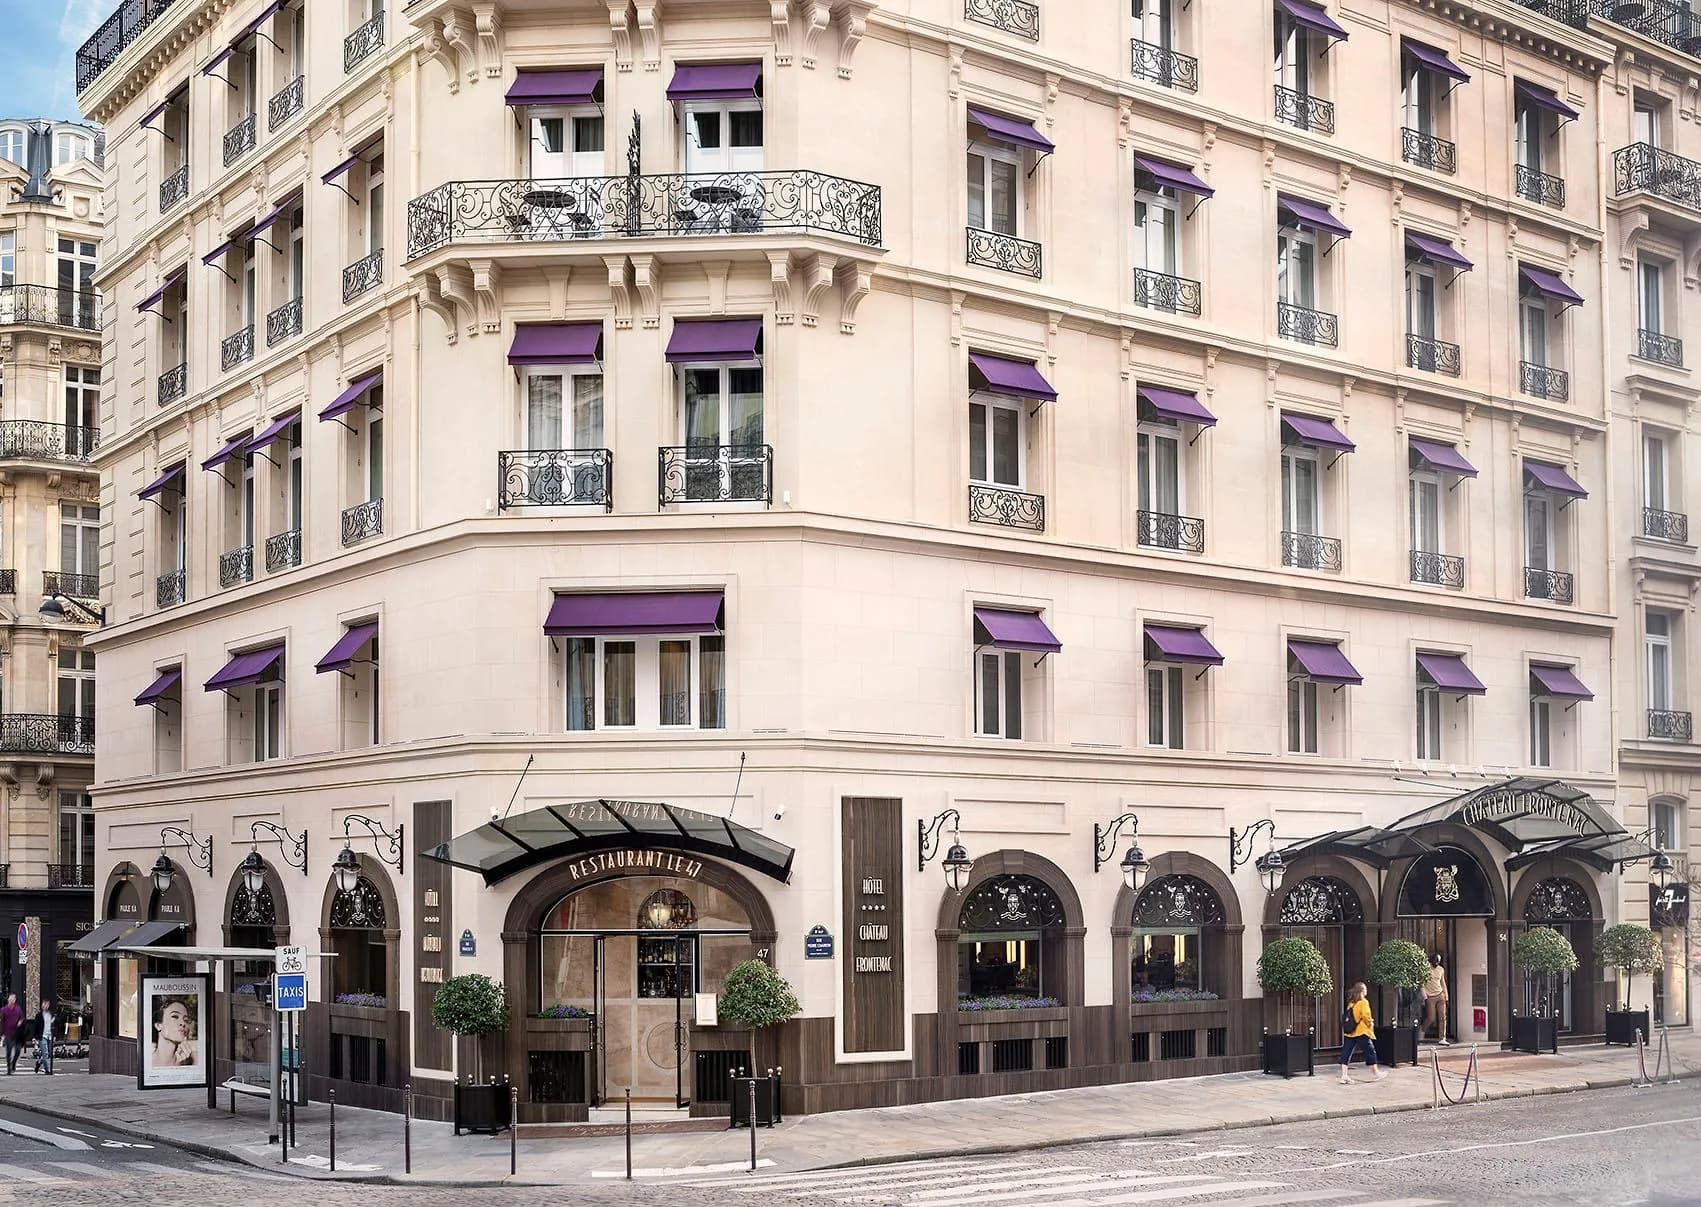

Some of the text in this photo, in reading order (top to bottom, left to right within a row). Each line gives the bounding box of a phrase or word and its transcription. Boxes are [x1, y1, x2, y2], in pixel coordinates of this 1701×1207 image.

[569, 850, 702, 880] RESTAURANT LE 47
[862, 876, 885, 894] HÔTEL
[859, 922, 888, 940] CHÂTEAU
[283, 947, 300, 955] SAUF
[757, 948, 769, 959] 47
[855, 956, 893, 972] FRONTENAC
[153, 984, 197, 992] MAUBOUSSIN
[278, 986, 304, 998] TAXIS
